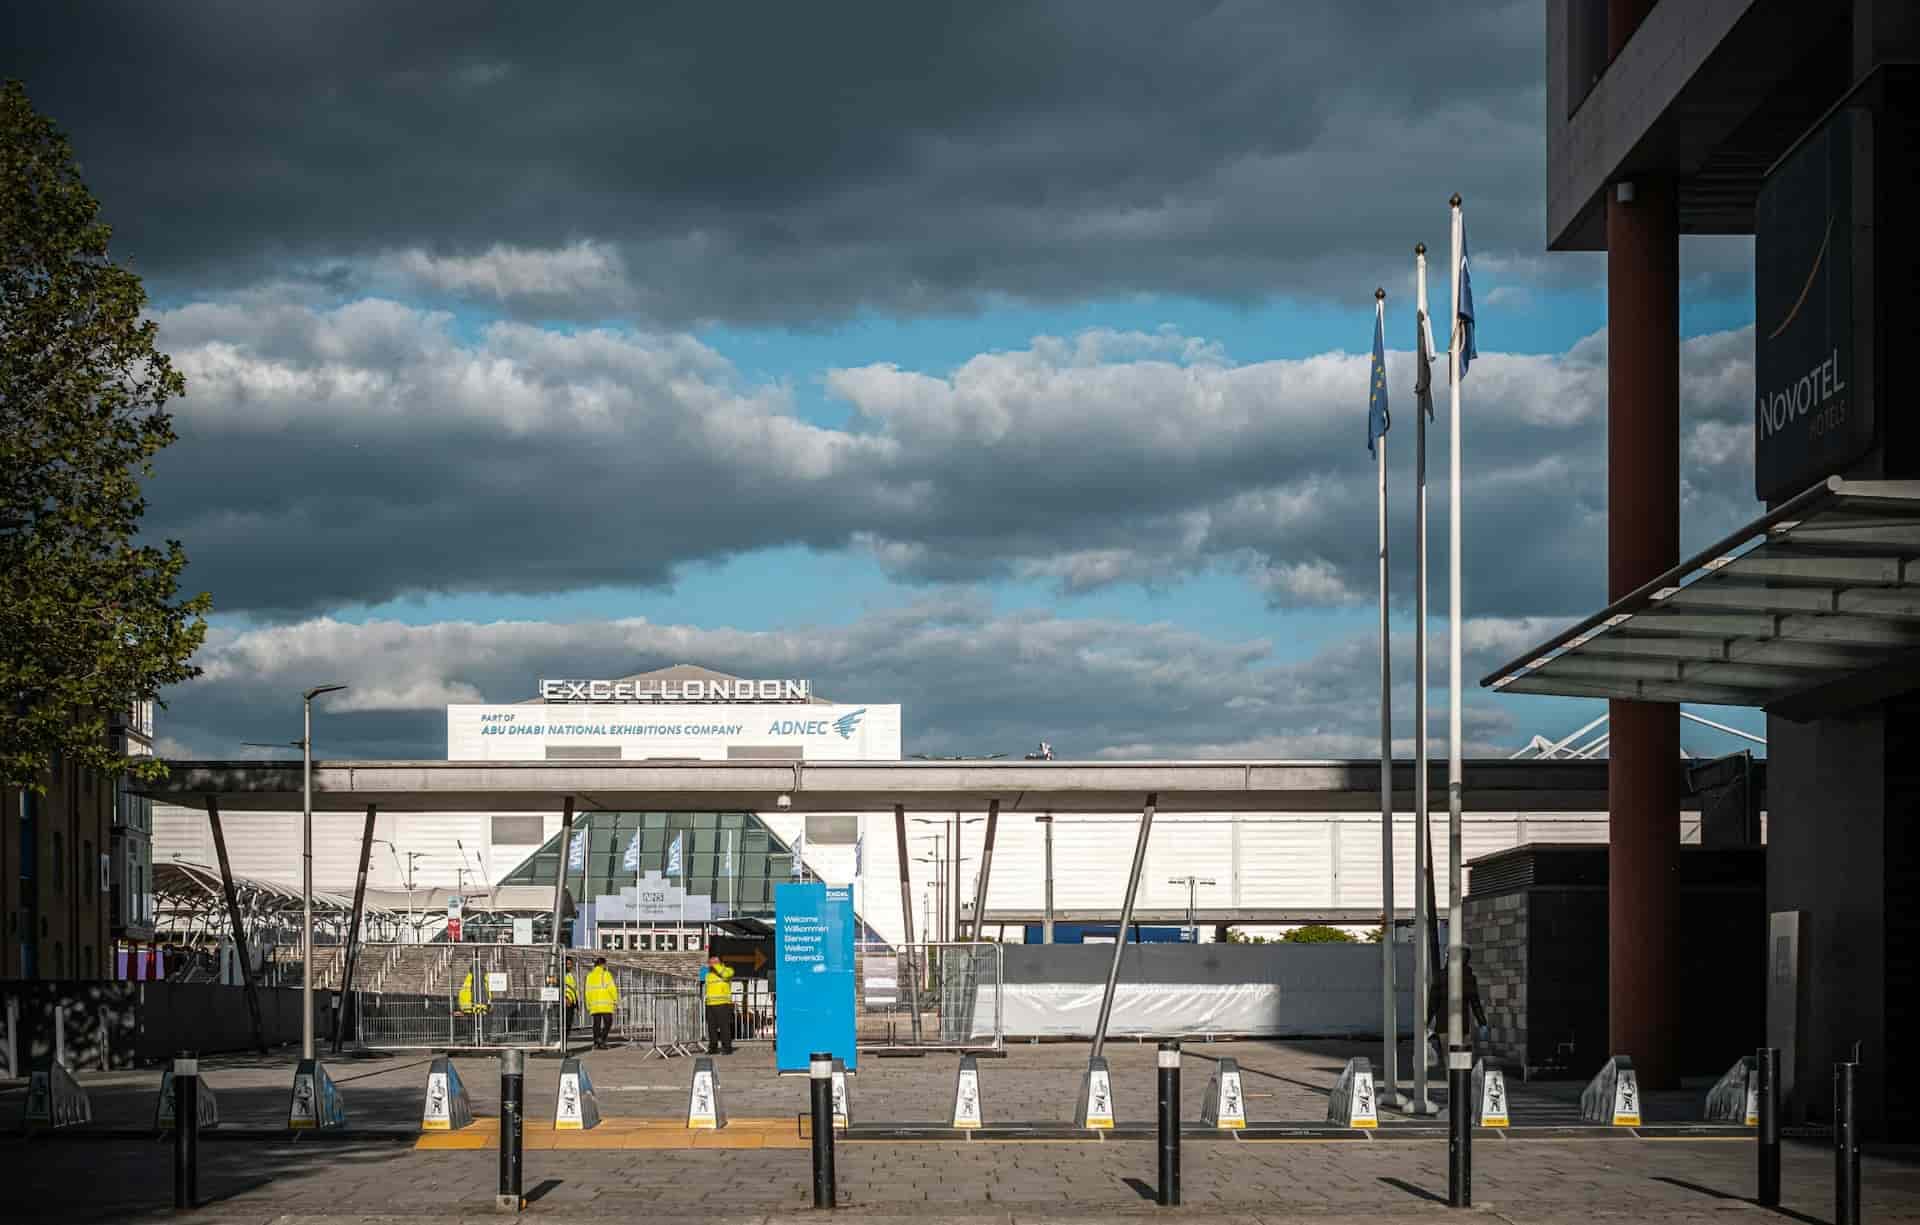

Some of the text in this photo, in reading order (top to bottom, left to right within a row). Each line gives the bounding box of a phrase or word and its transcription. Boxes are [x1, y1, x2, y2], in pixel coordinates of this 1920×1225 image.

[1759, 347, 1845, 440] NOVOTEL
[661, 679, 807, 700] LONDON
[480, 713, 516, 722] PART OF
[480, 724, 743, 736] ABU DHABI NATIONAL EXHIBITIONS COMPANY
[768, 720, 829, 735] ADNEC
[784, 915, 818, 923] Welcome
[784, 925, 829, 933] Willkommen
